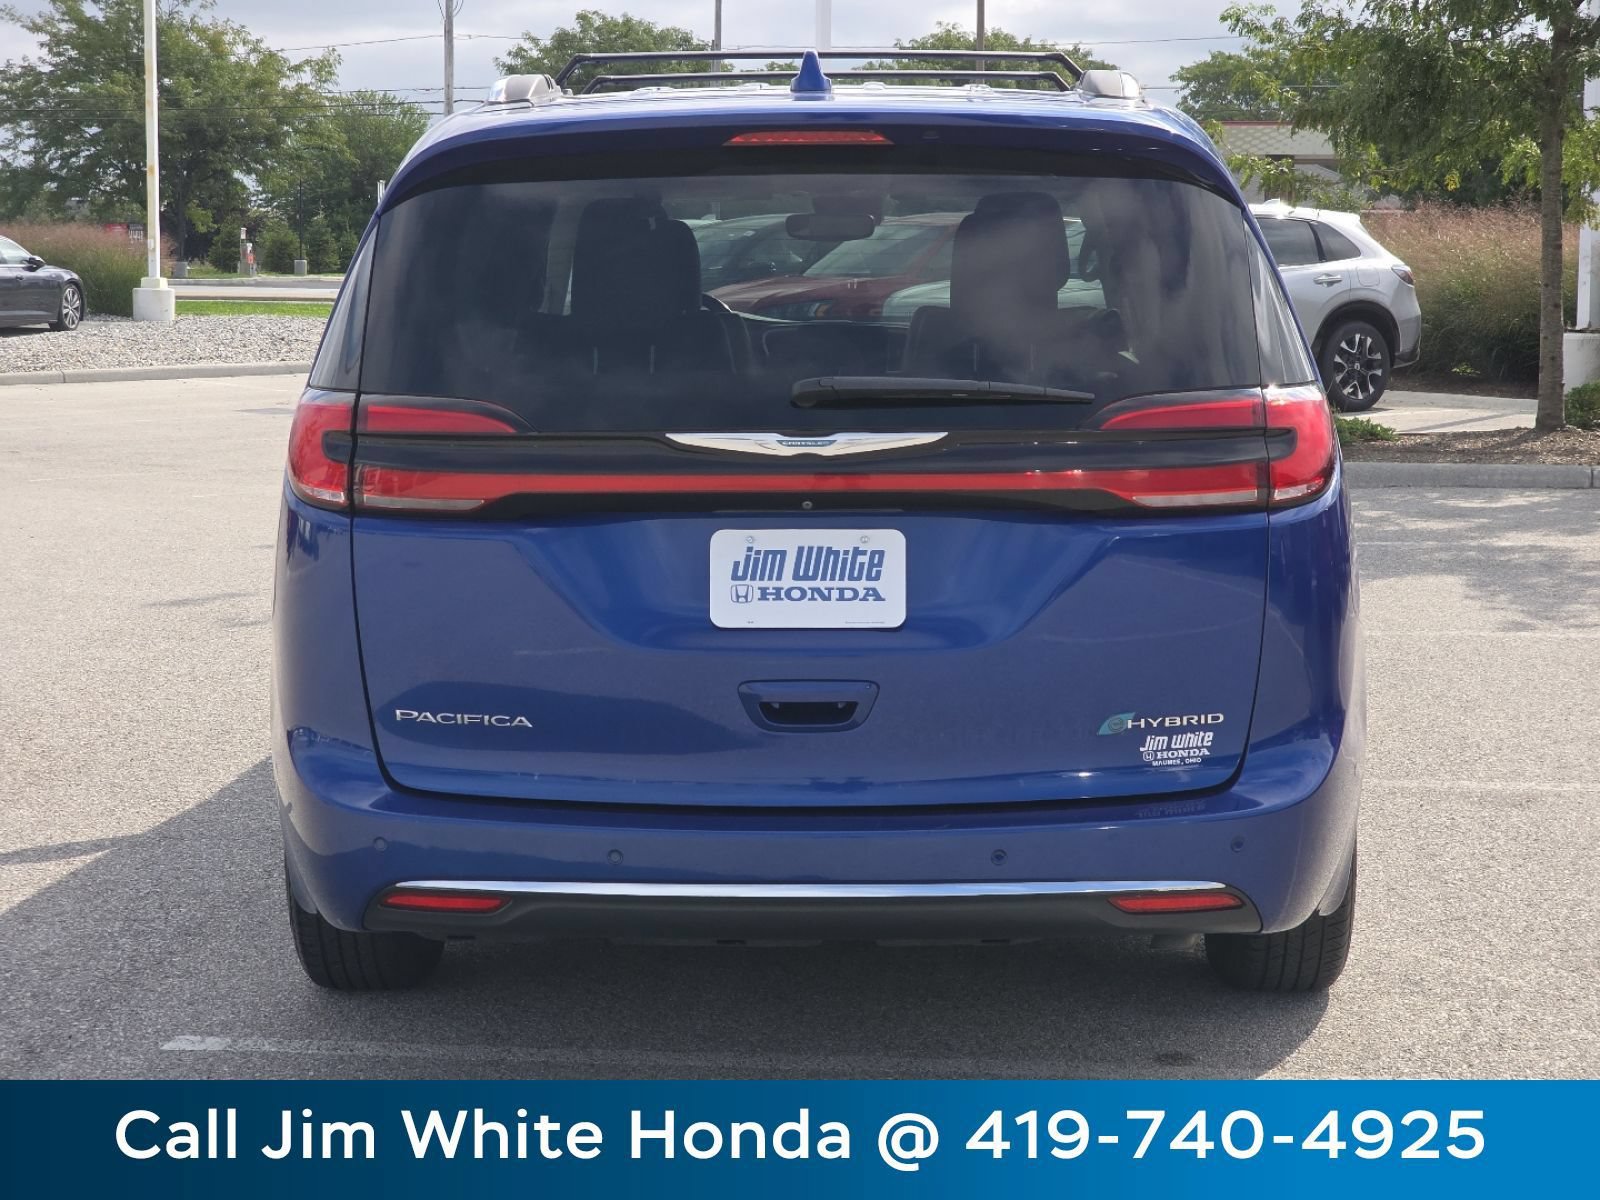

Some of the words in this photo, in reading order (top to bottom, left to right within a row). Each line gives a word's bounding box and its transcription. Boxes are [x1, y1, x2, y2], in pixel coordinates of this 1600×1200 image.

[730, 546, 787, 581] Jim
[792, 546, 885, 581] White
[757, 586, 886, 602] HONDA
[395, 709, 533, 728] PACIFICA
[1127, 712, 1225, 729] HYBRID
[1140, 735, 1168, 752] Jim
[1171, 731, 1214, 749] White
[1156, 748, 1211, 760] HONDA
[1184, 757, 1202, 765] OHIO
